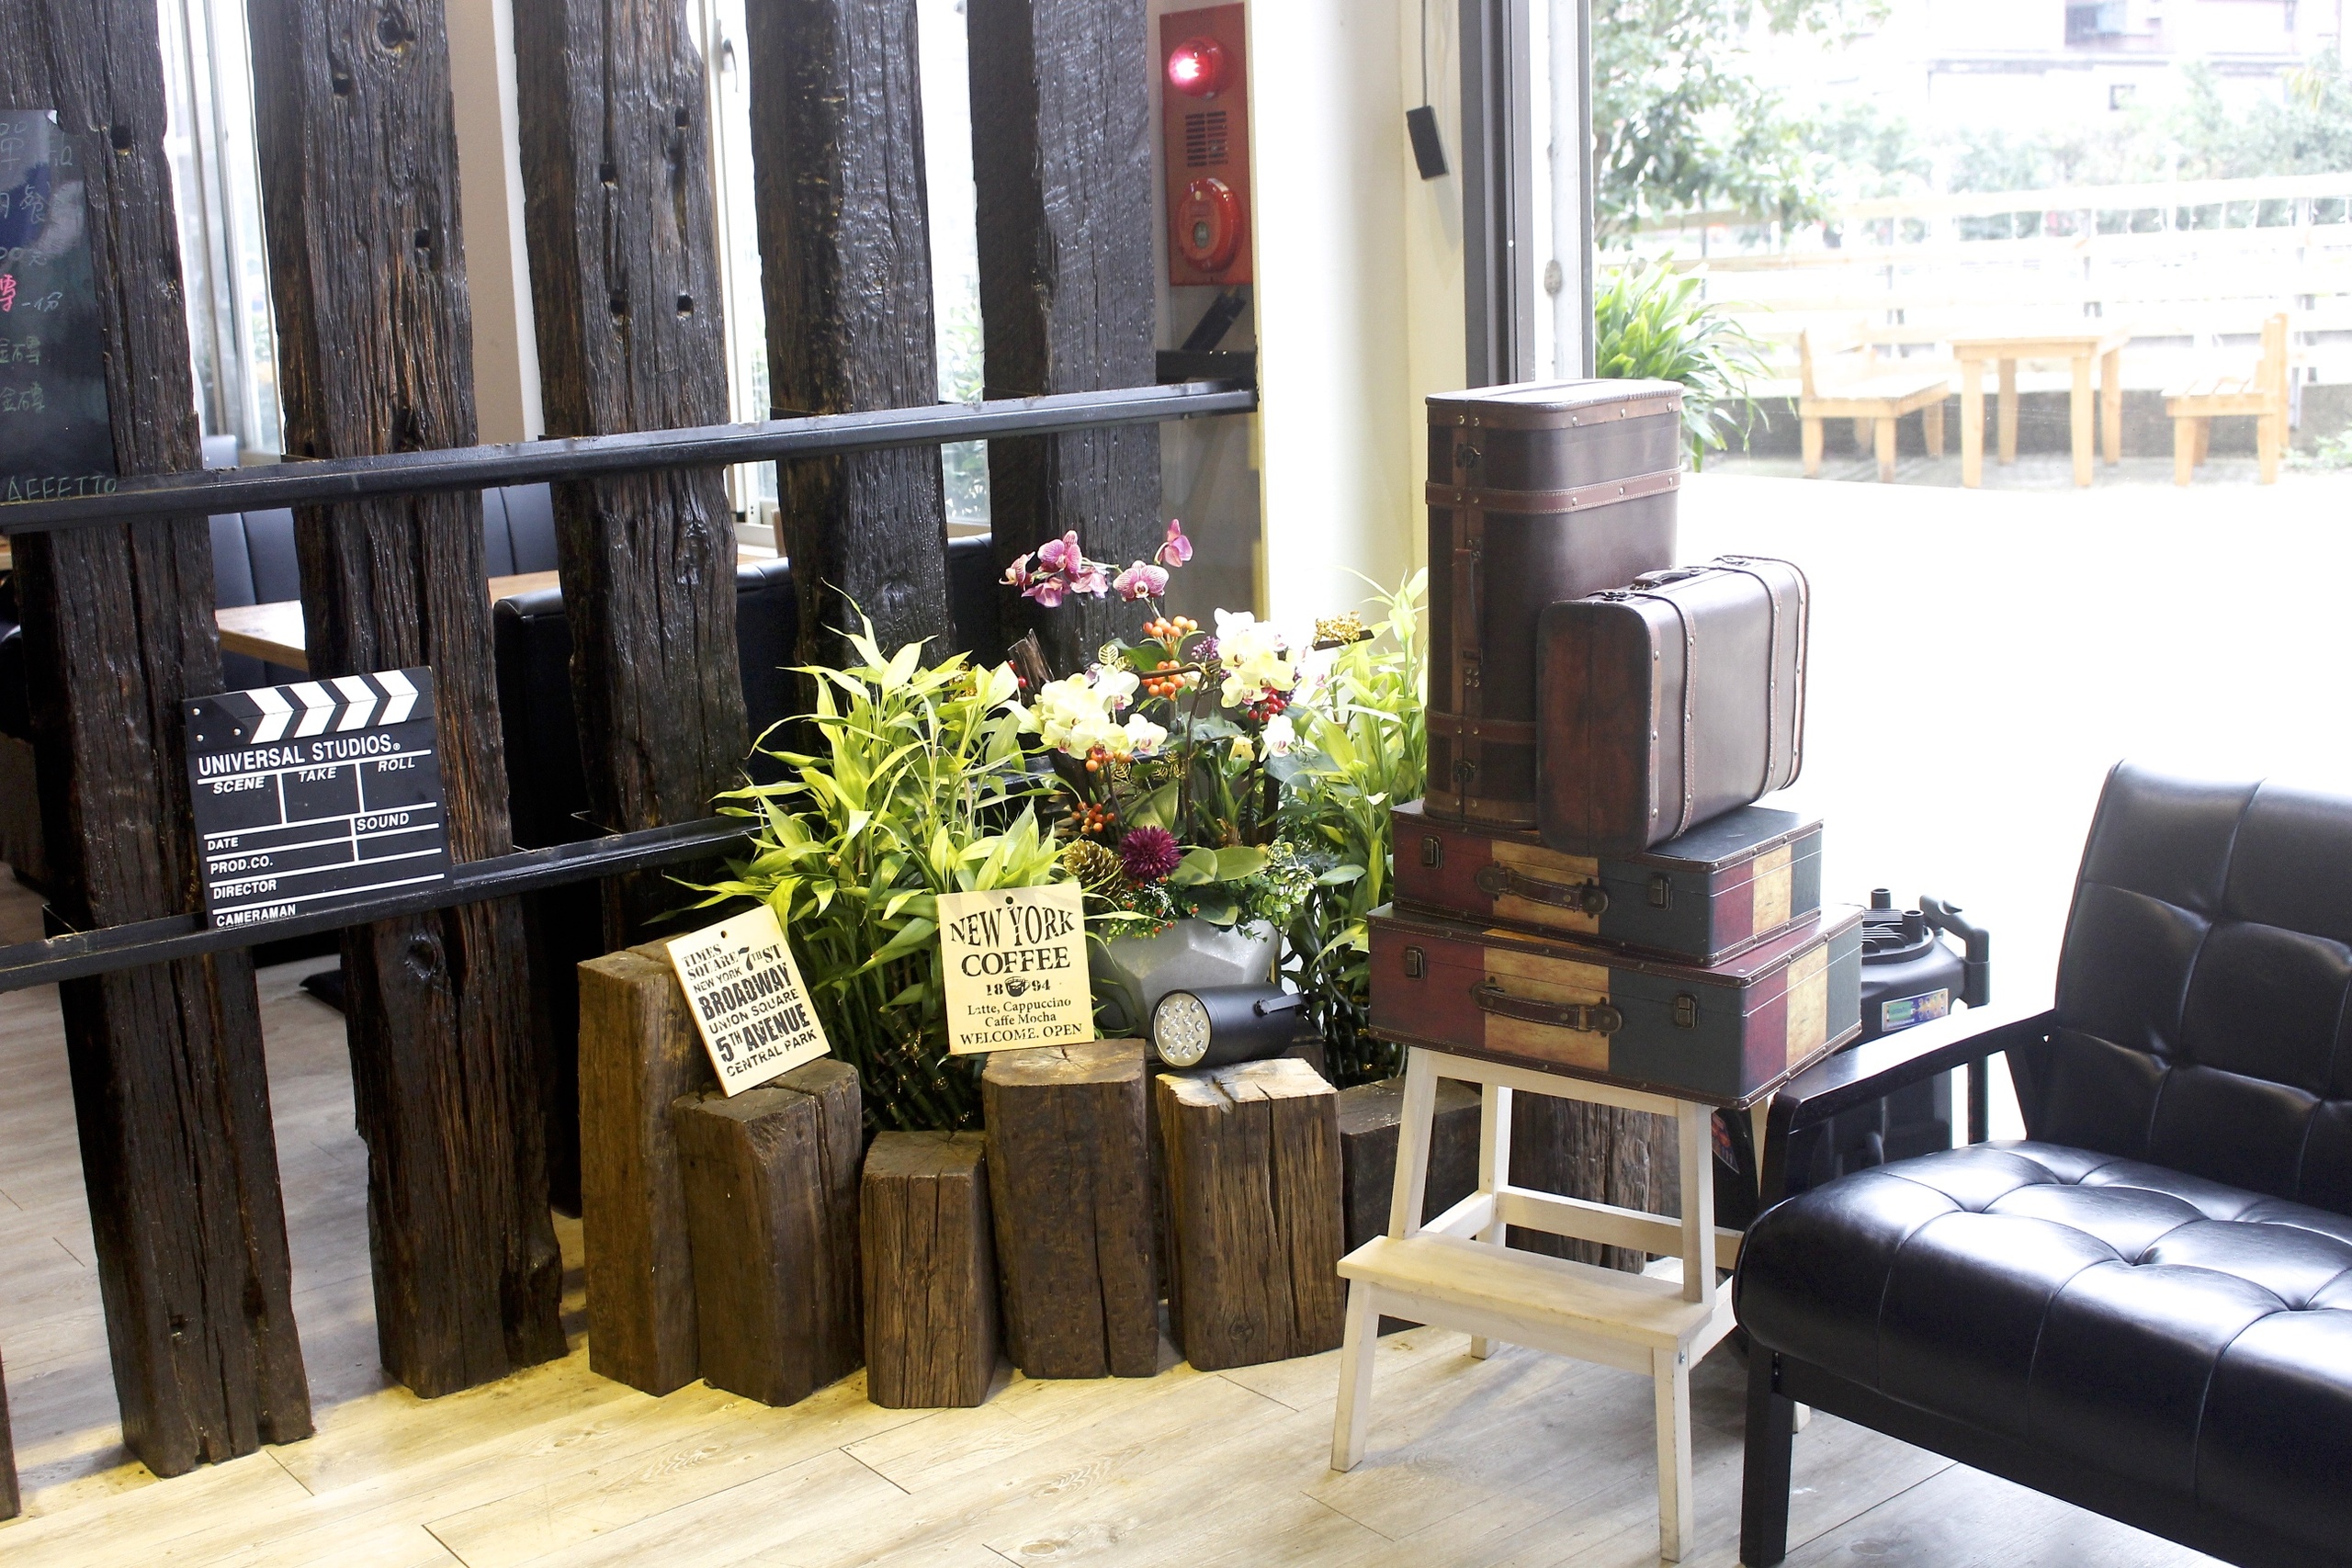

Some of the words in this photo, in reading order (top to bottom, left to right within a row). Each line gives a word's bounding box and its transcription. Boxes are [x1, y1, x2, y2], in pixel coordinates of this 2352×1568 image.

[198, 744, 305, 776] UNIVERSAL
[378, 757, 416, 773] ROLL
[213, 776, 266, 795] SCENE
[299, 767, 336, 783] TAKE
[356, 813, 410, 831] SOUND
[208, 838, 239, 852] DATE
[210, 855, 273, 874] PROD.CO.
[213, 880, 277, 899] DIRECTOR
[216, 904, 296, 928] CAMERAMAN
[950, 908, 1001, 947] NEW
[1007, 905, 1075, 946] YORK
[682, 944, 722, 967] TIMES
[687, 952, 739, 980] SQUARE
[961, 947, 1070, 976] COFFEE
[694, 978, 715, 994] NEW
[718, 967, 742, 984] YORK
[698, 963, 792, 1021] BROADWAY
[709, 1011, 749, 1034] UNION
[753, 988, 799, 1017] SQUARE
[967, 1004, 1001, 1015] Latte,
[1003, 998, 1071, 1014] Cappuccino
[985, 1014, 1014, 1027] Caffe
[1018, 1011, 1057, 1024] Mocha
[715, 1032, 743, 1062] 5TH
[742, 1003, 810, 1052] AVENUE
[960, 1028, 1039, 1045] WELCOME.
[1043, 1023, 1082, 1037] OPEN
[727, 1044, 783, 1077] CENTRAL
[786, 1029, 817, 1052] PARK
